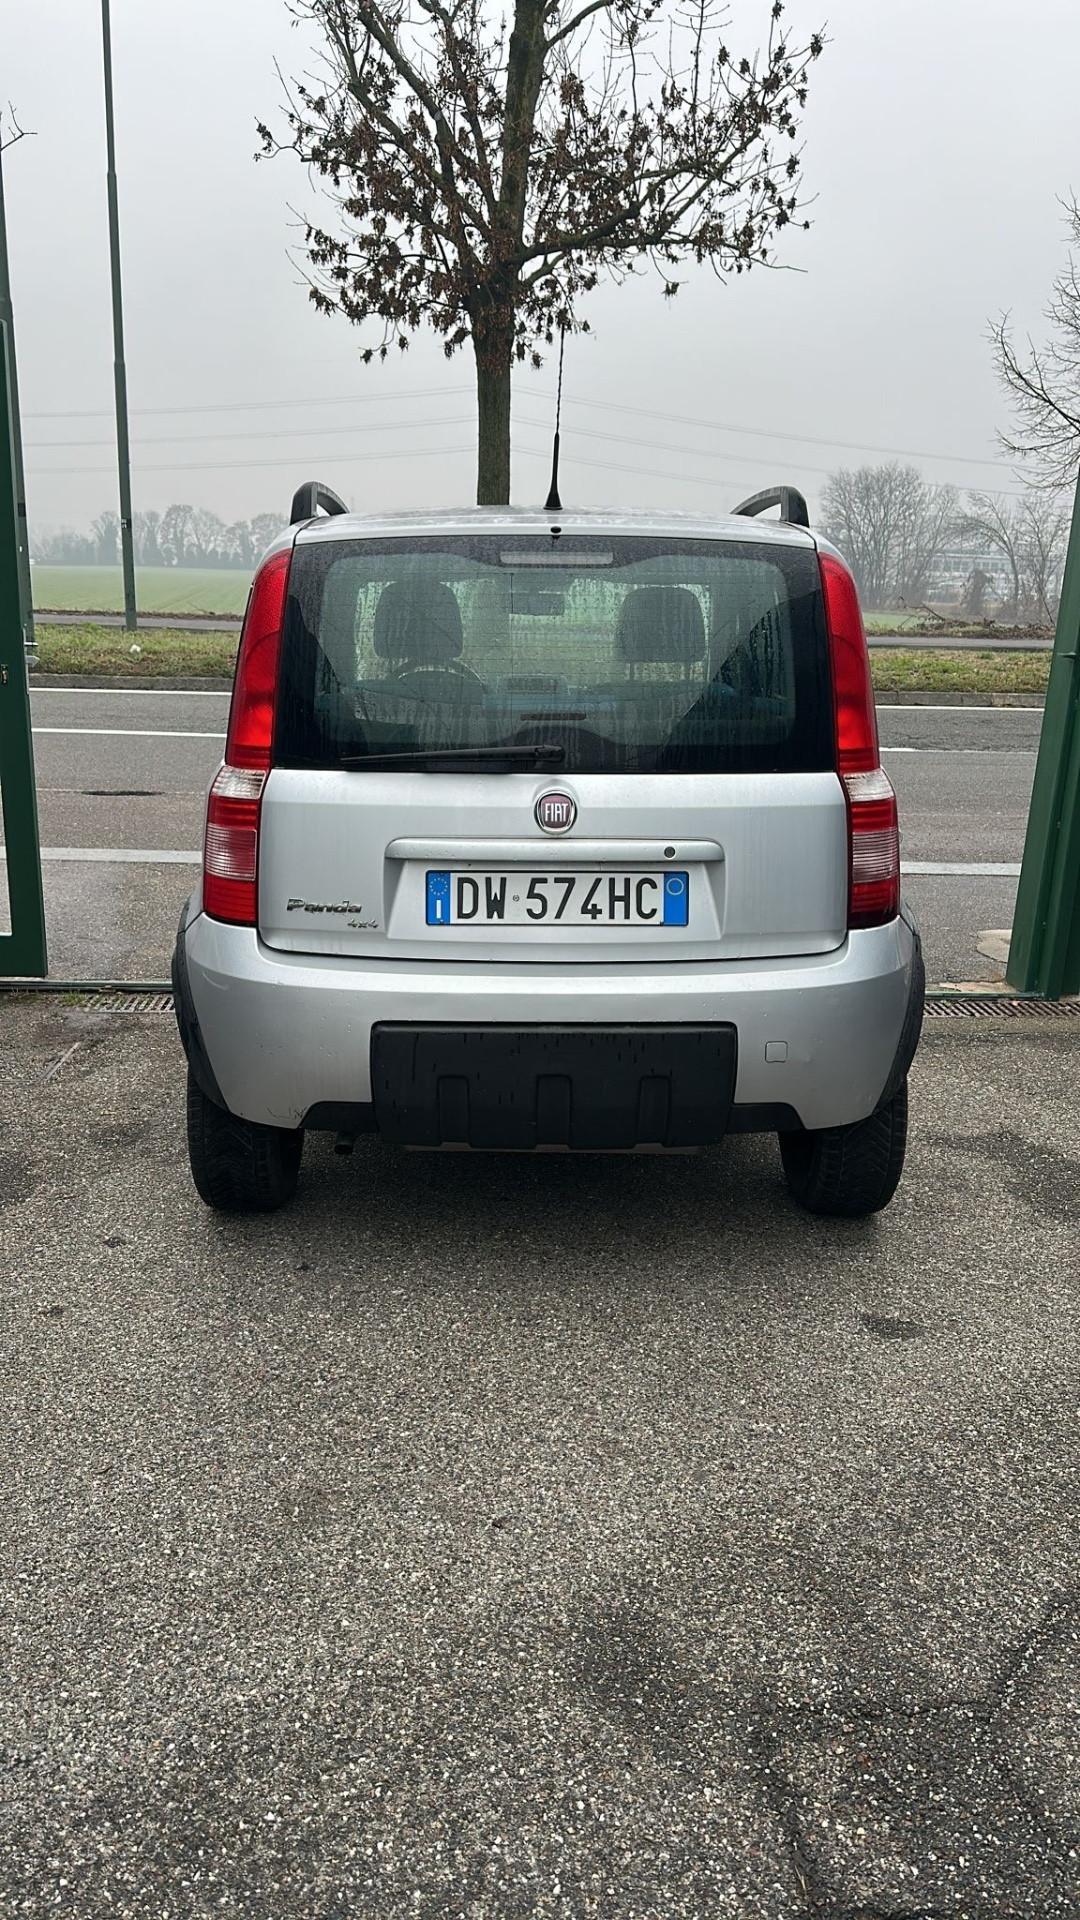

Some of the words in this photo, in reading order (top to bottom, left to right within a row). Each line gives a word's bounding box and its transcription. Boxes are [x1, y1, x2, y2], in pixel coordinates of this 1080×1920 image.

[544, 803, 569, 822] FIAT
[286, 898, 362, 914] Panda
[456, 877, 507, 920] DW
[526, 877, 658, 920] 574HC
[435, 899, 442, 919] I
[347, 919, 379, 929] 4x4
